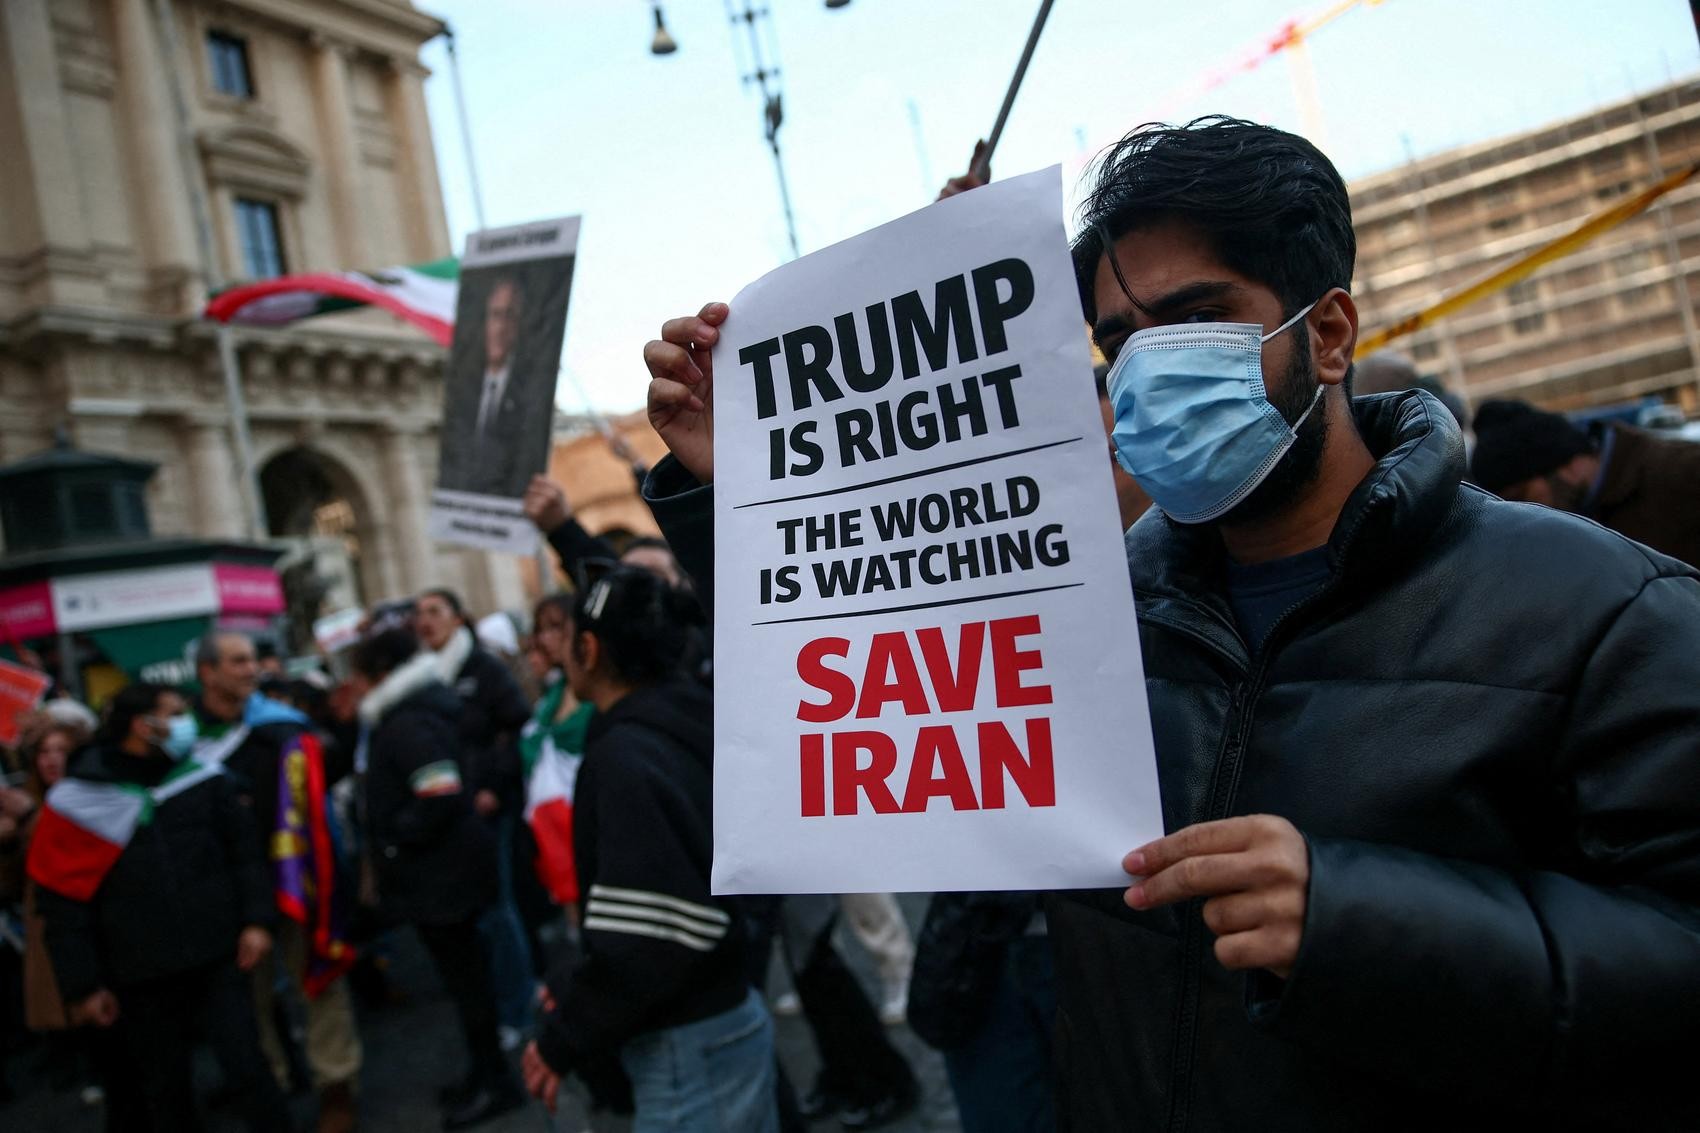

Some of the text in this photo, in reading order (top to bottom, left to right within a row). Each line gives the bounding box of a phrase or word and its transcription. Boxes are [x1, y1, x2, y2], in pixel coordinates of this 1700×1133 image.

[739, 257, 1035, 420] TRUMP
[769, 364, 1023, 481] IS RIGHT
[760, 523, 1071, 605] IS WATCHING
[776, 475, 1041, 556] THE WORLD
[796, 614, 1054, 723] SAVE
[799, 716, 1056, 818] IRAN
